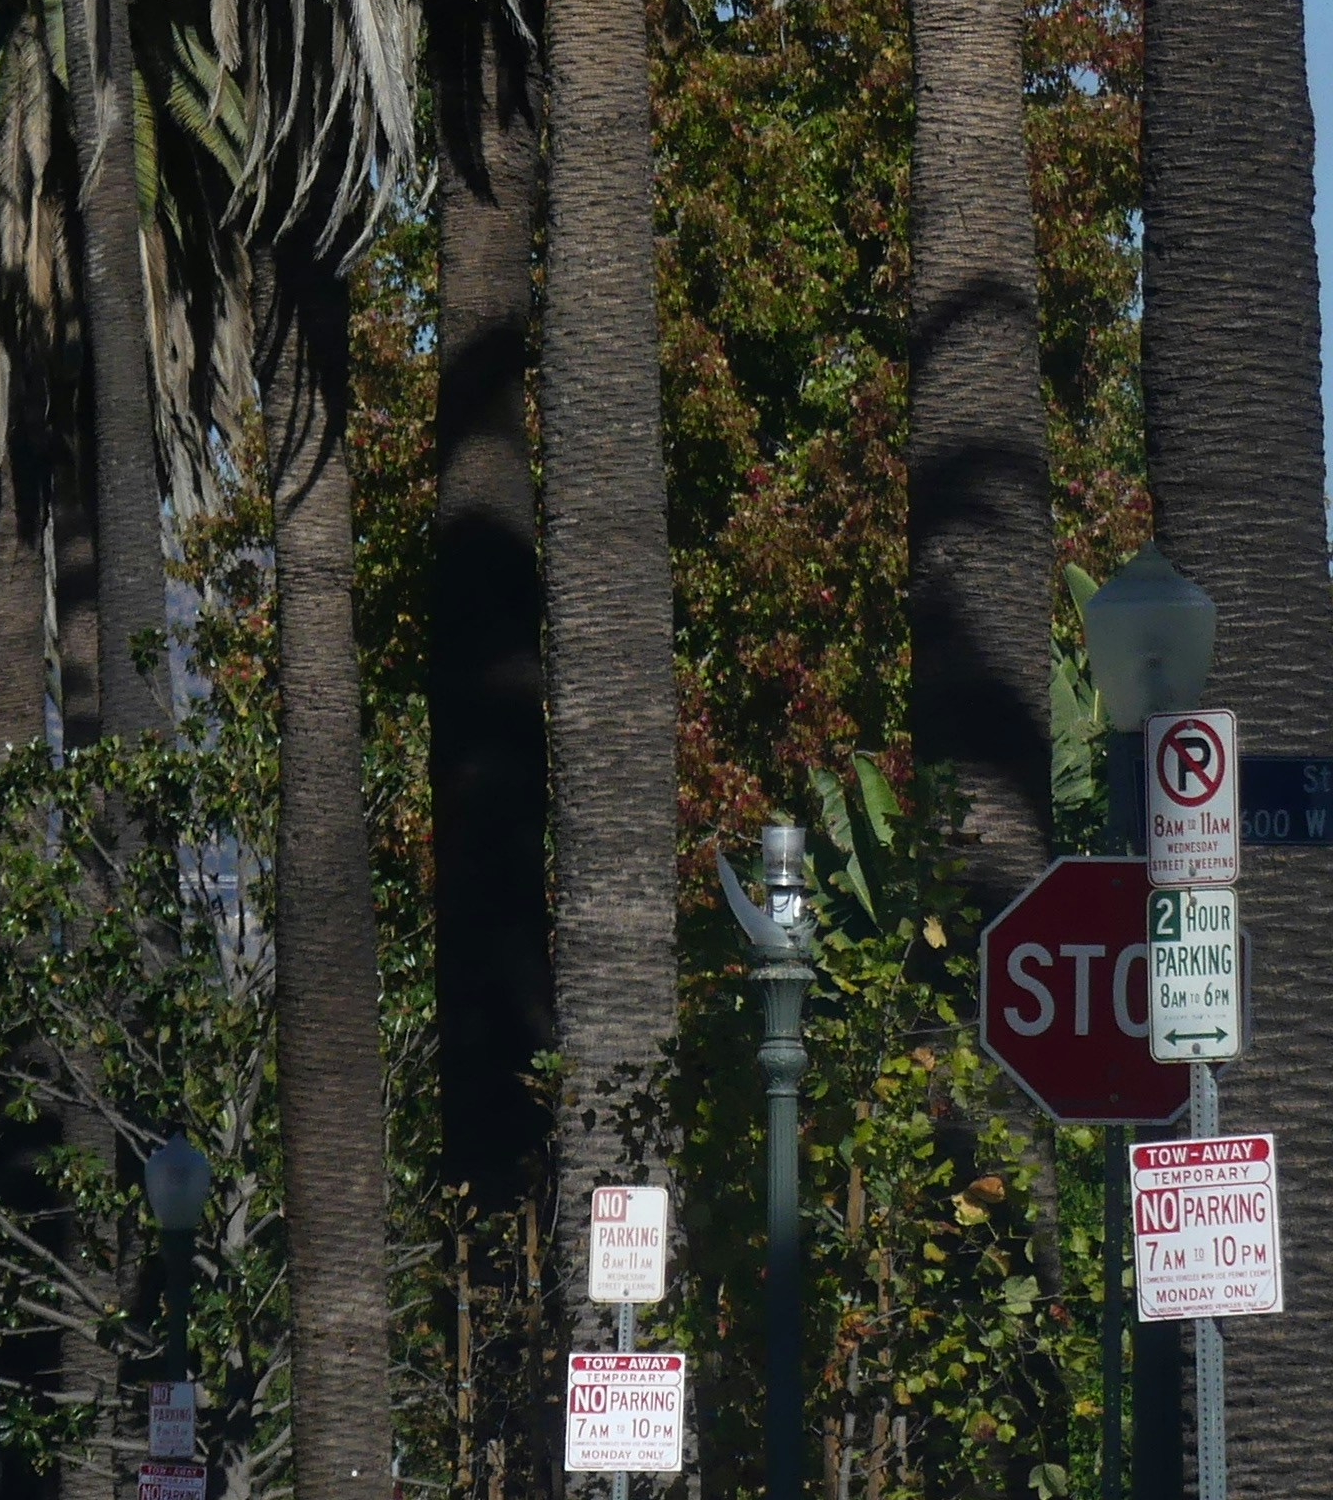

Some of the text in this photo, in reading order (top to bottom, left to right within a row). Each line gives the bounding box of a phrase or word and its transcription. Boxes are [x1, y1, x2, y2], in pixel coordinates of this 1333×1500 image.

[1306, 808, 1326, 837] W
[1167, 841, 1218, 854] WEDNESDAY
[1152, 856, 1234, 871] STREET SWEEPING
[1156, 898, 1231, 935] 2 HOUR
[1156, 944, 1232, 977] PARKING
[1004, 943, 1150, 1038] STO
[1152, 1167, 1250, 1186] TEMPORARY
[598, 1193, 623, 1218] NO
[1142, 1192, 1265, 1231] NO PARKING
[599, 1227, 659, 1247] PARKING
[1156, 1284, 1258, 1303] MONDAY ONLY
[586, 1373, 666, 1383] TEMPORARY
[153, 1386, 168, 1402] NO
[574, 1386, 675, 1412] NO PARKING
[153, 1409, 191, 1421] PARKING
[581, 1450, 665, 1460] MONDAY ONLY
[141, 1485, 201, 1500] NO PARKING
